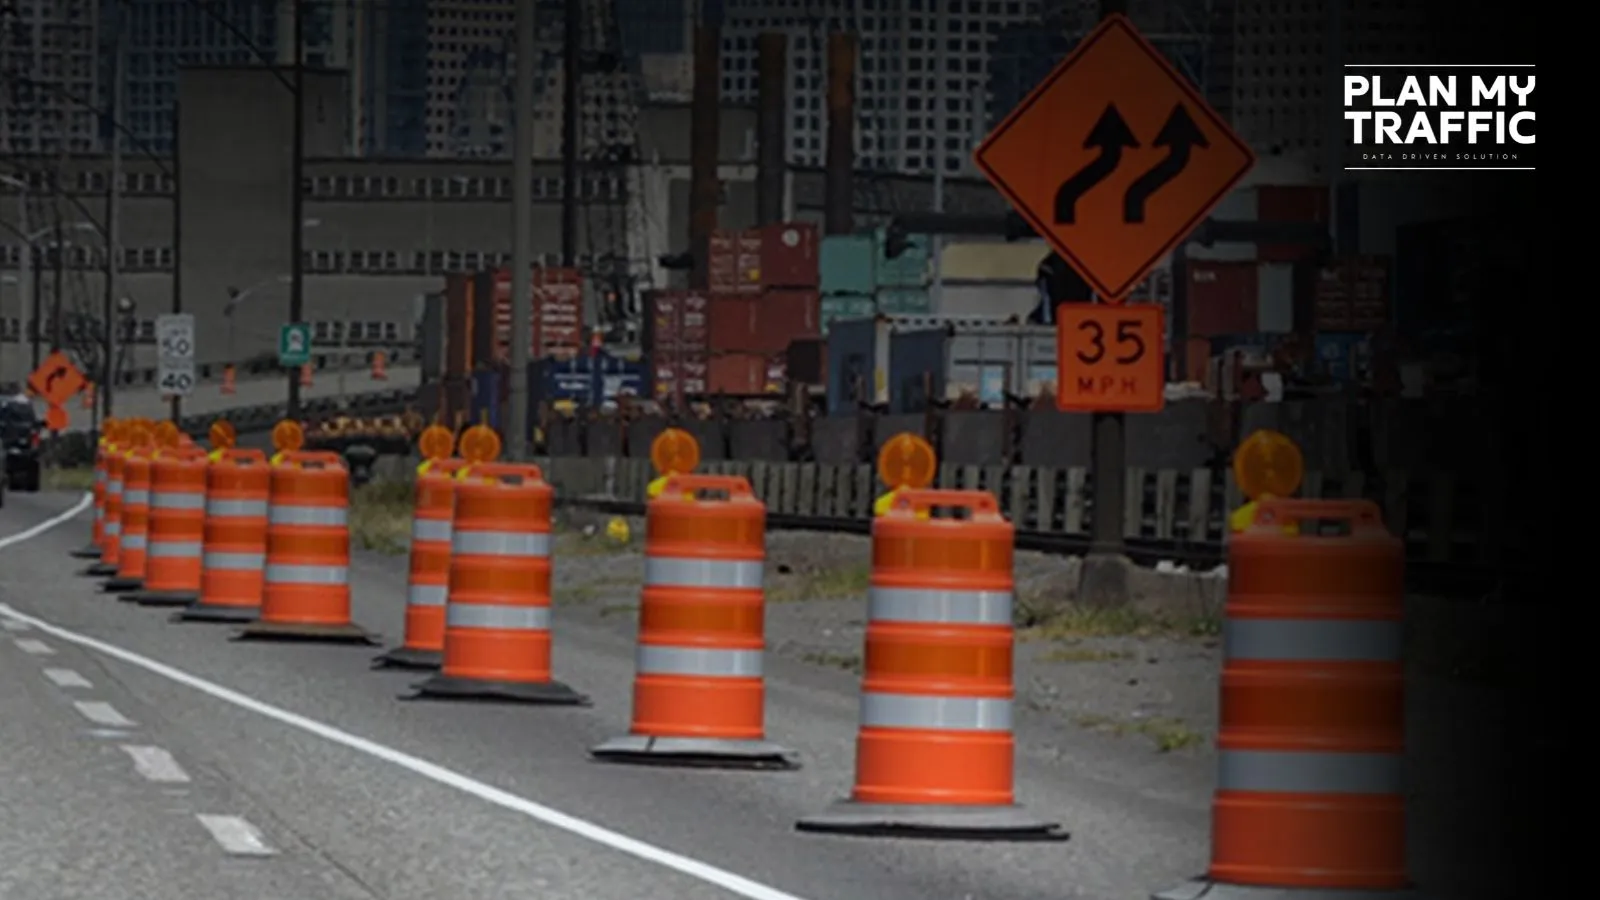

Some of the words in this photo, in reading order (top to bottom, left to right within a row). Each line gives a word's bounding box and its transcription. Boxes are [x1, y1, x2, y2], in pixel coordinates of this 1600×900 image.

[162, 339, 190, 356] 50
[1076, 320, 1145, 365] 35
[162, 372, 192, 390] 40
[1077, 375, 1137, 395] MPH
